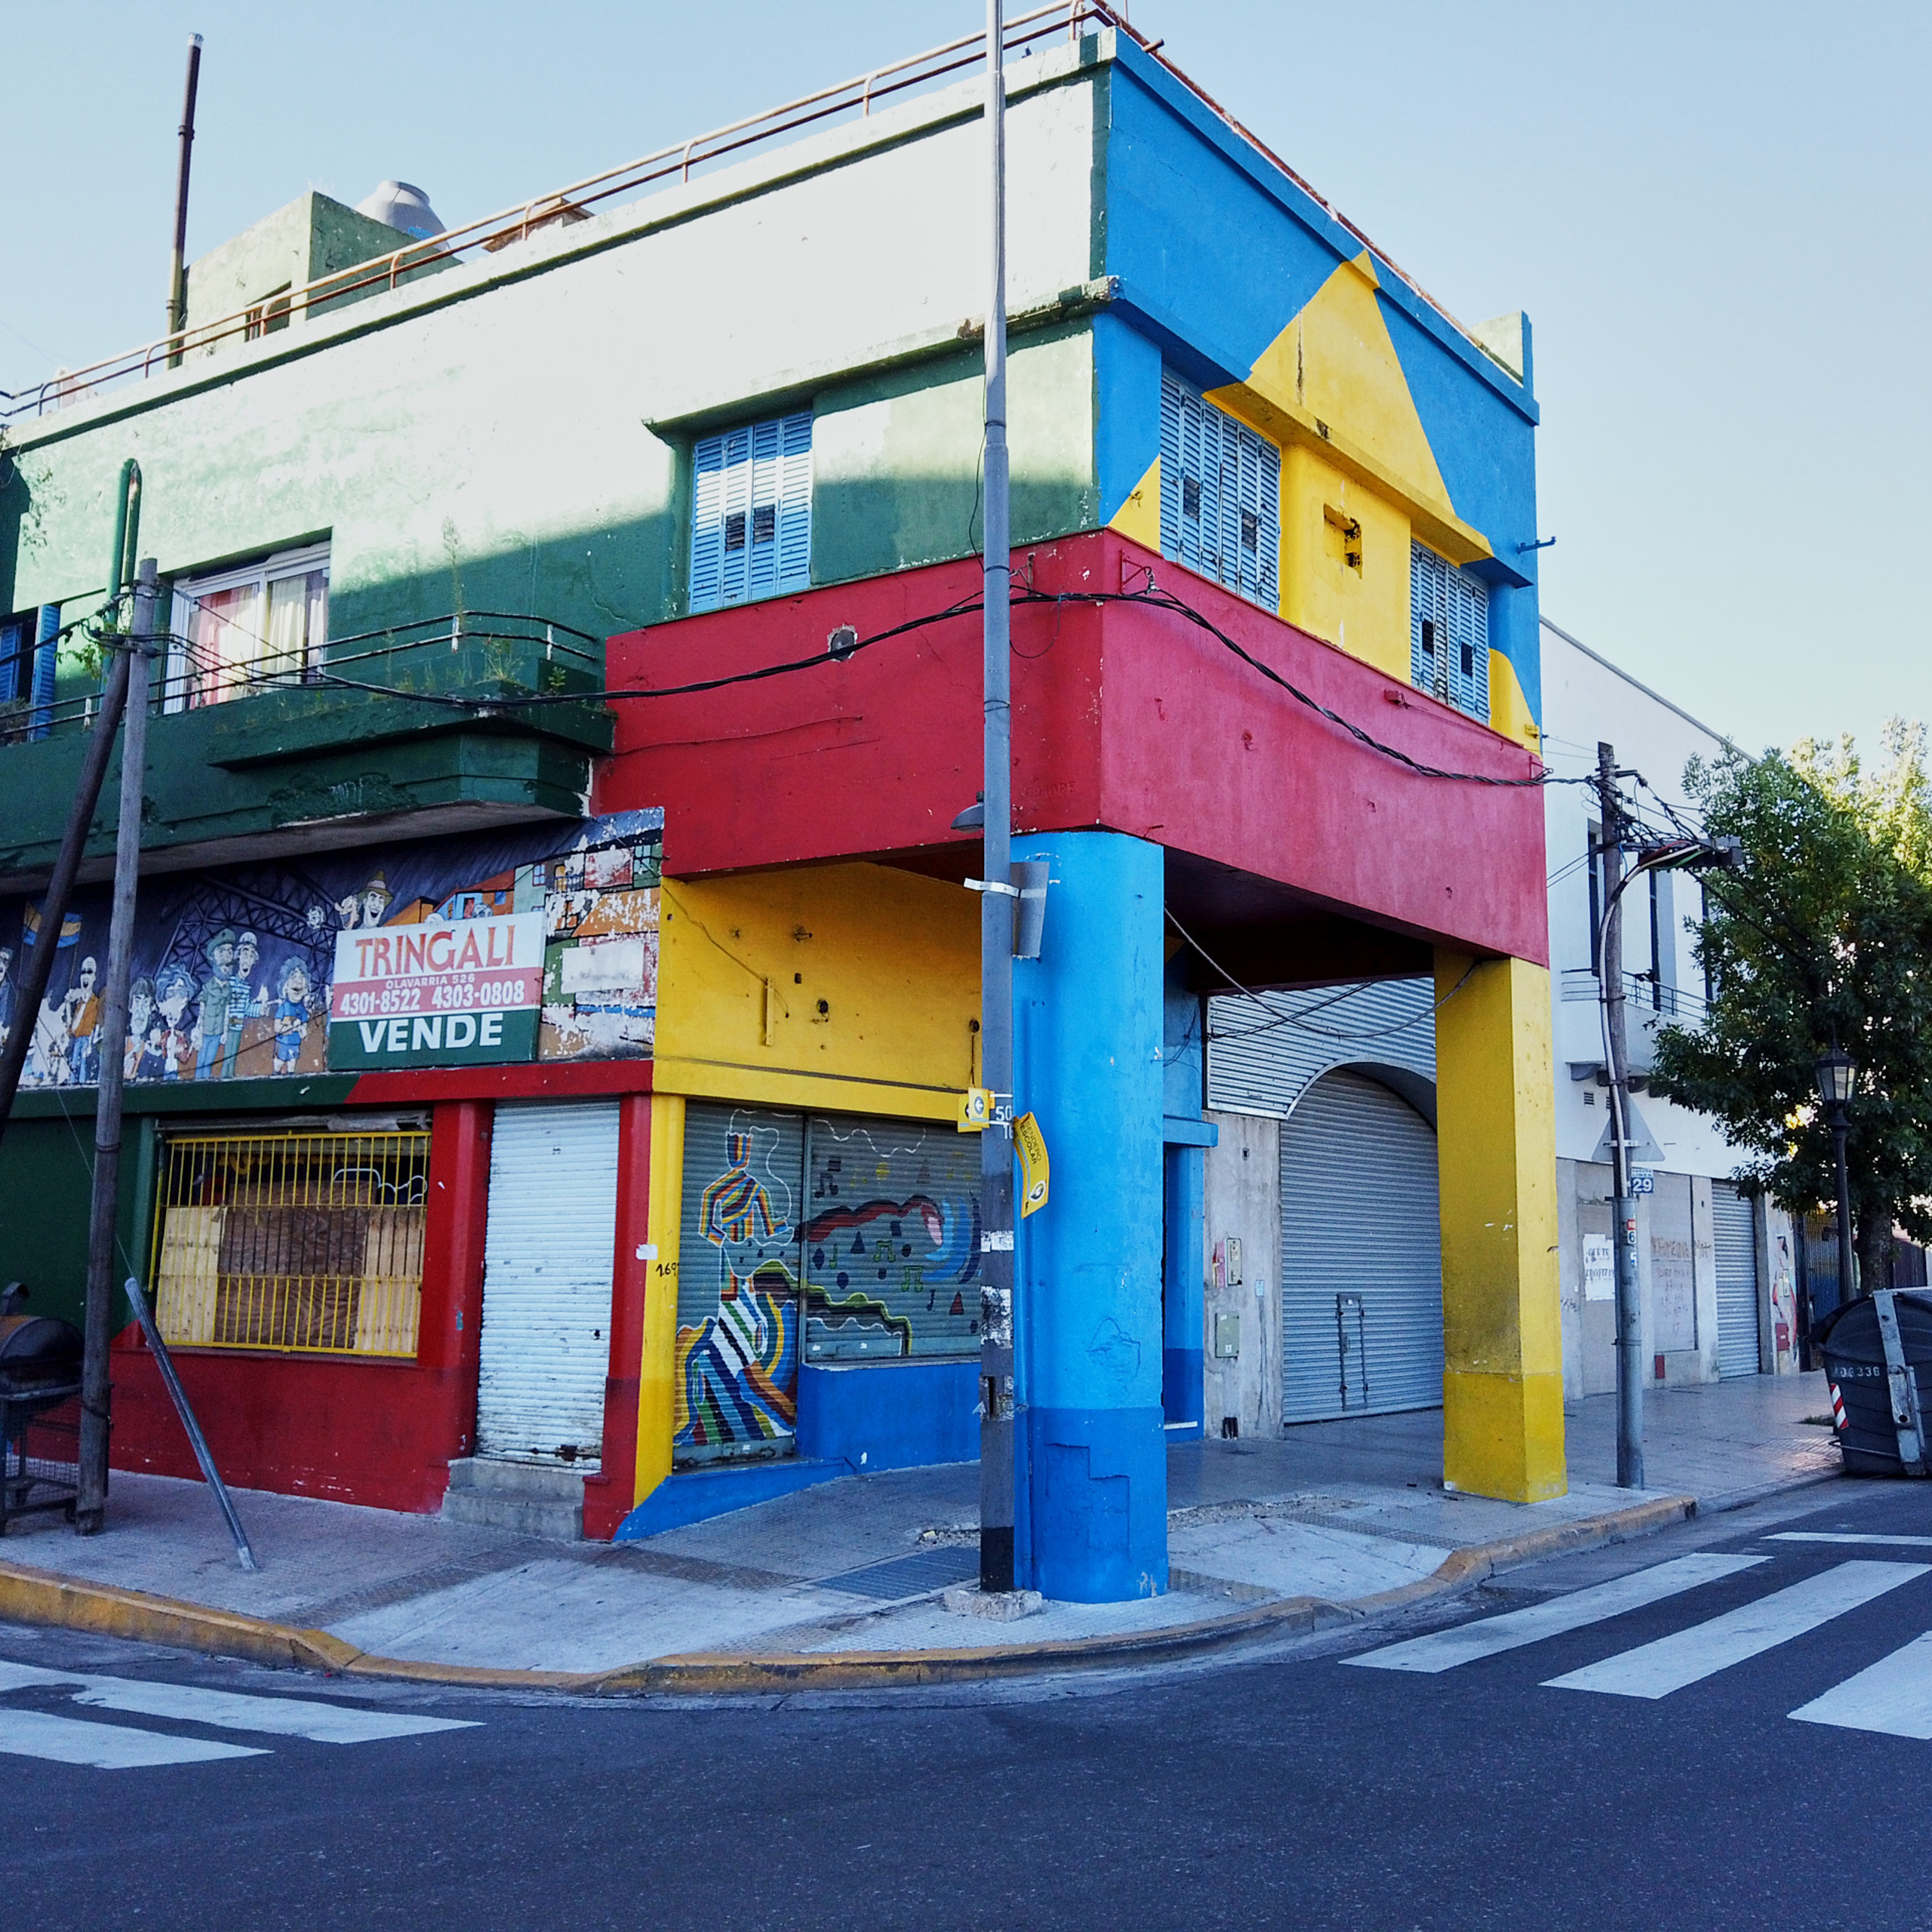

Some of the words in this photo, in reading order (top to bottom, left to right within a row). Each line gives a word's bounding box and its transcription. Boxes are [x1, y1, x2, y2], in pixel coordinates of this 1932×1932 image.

[355, 924, 515, 977] TRINGALI
[340, 988, 421, 1015] 4301-8522
[432, 980, 525, 1009] 4303-0808
[386, 976, 448, 989] OLAVARRIA
[452, 974, 475, 983] 526
[358, 1013, 503, 1053] VENDE
[1020, 1124, 1037, 1164] ESCOLAR
[1026, 1121, 1042, 1161] SENDERO
[1632, 1176, 1652, 1192] 29
